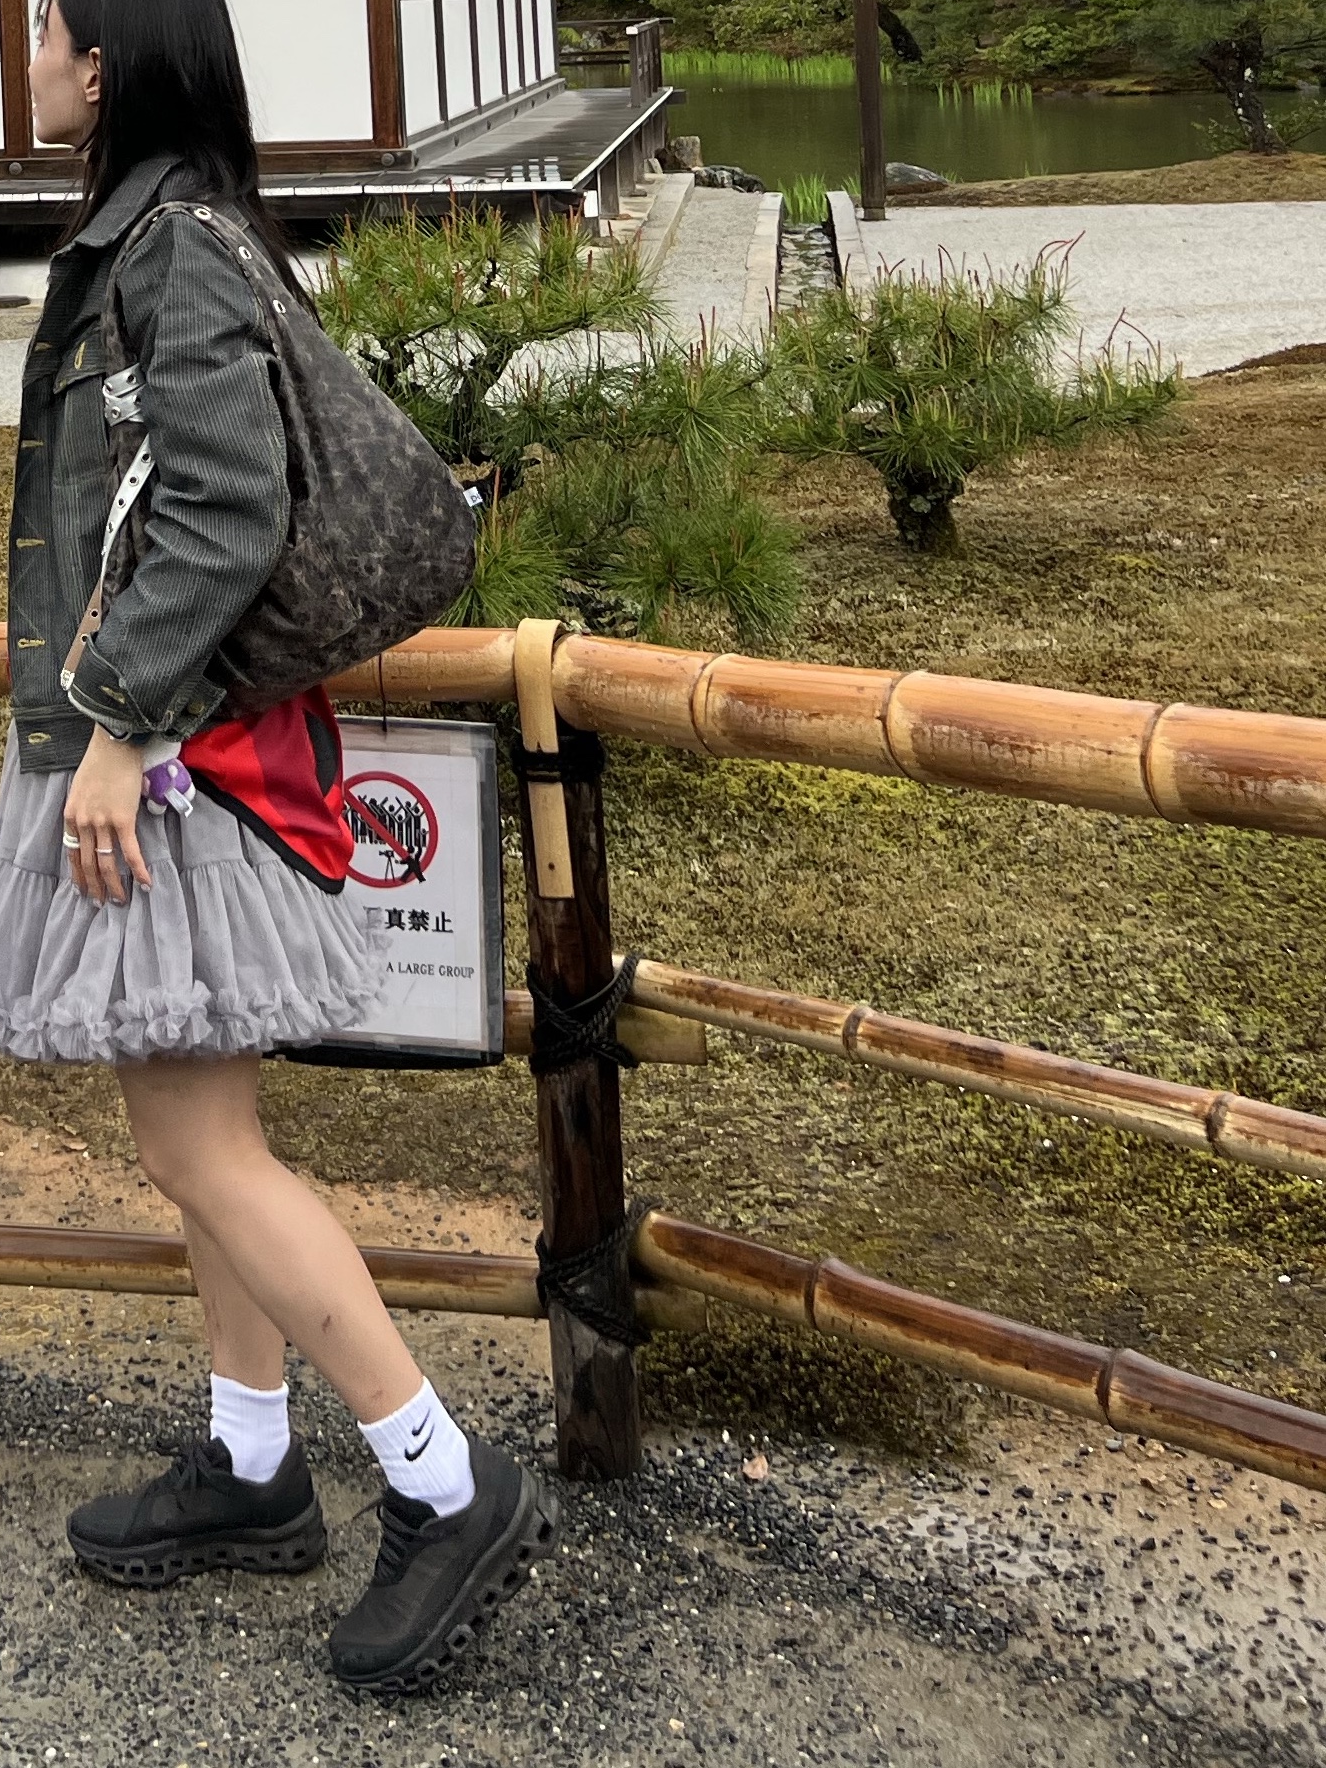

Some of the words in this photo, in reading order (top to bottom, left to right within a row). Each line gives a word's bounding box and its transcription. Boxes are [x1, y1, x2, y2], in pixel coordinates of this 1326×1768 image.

[386, 962, 394, 973] A
[398, 962, 435, 976] LARGE
[439, 964, 475, 979] GROUP
